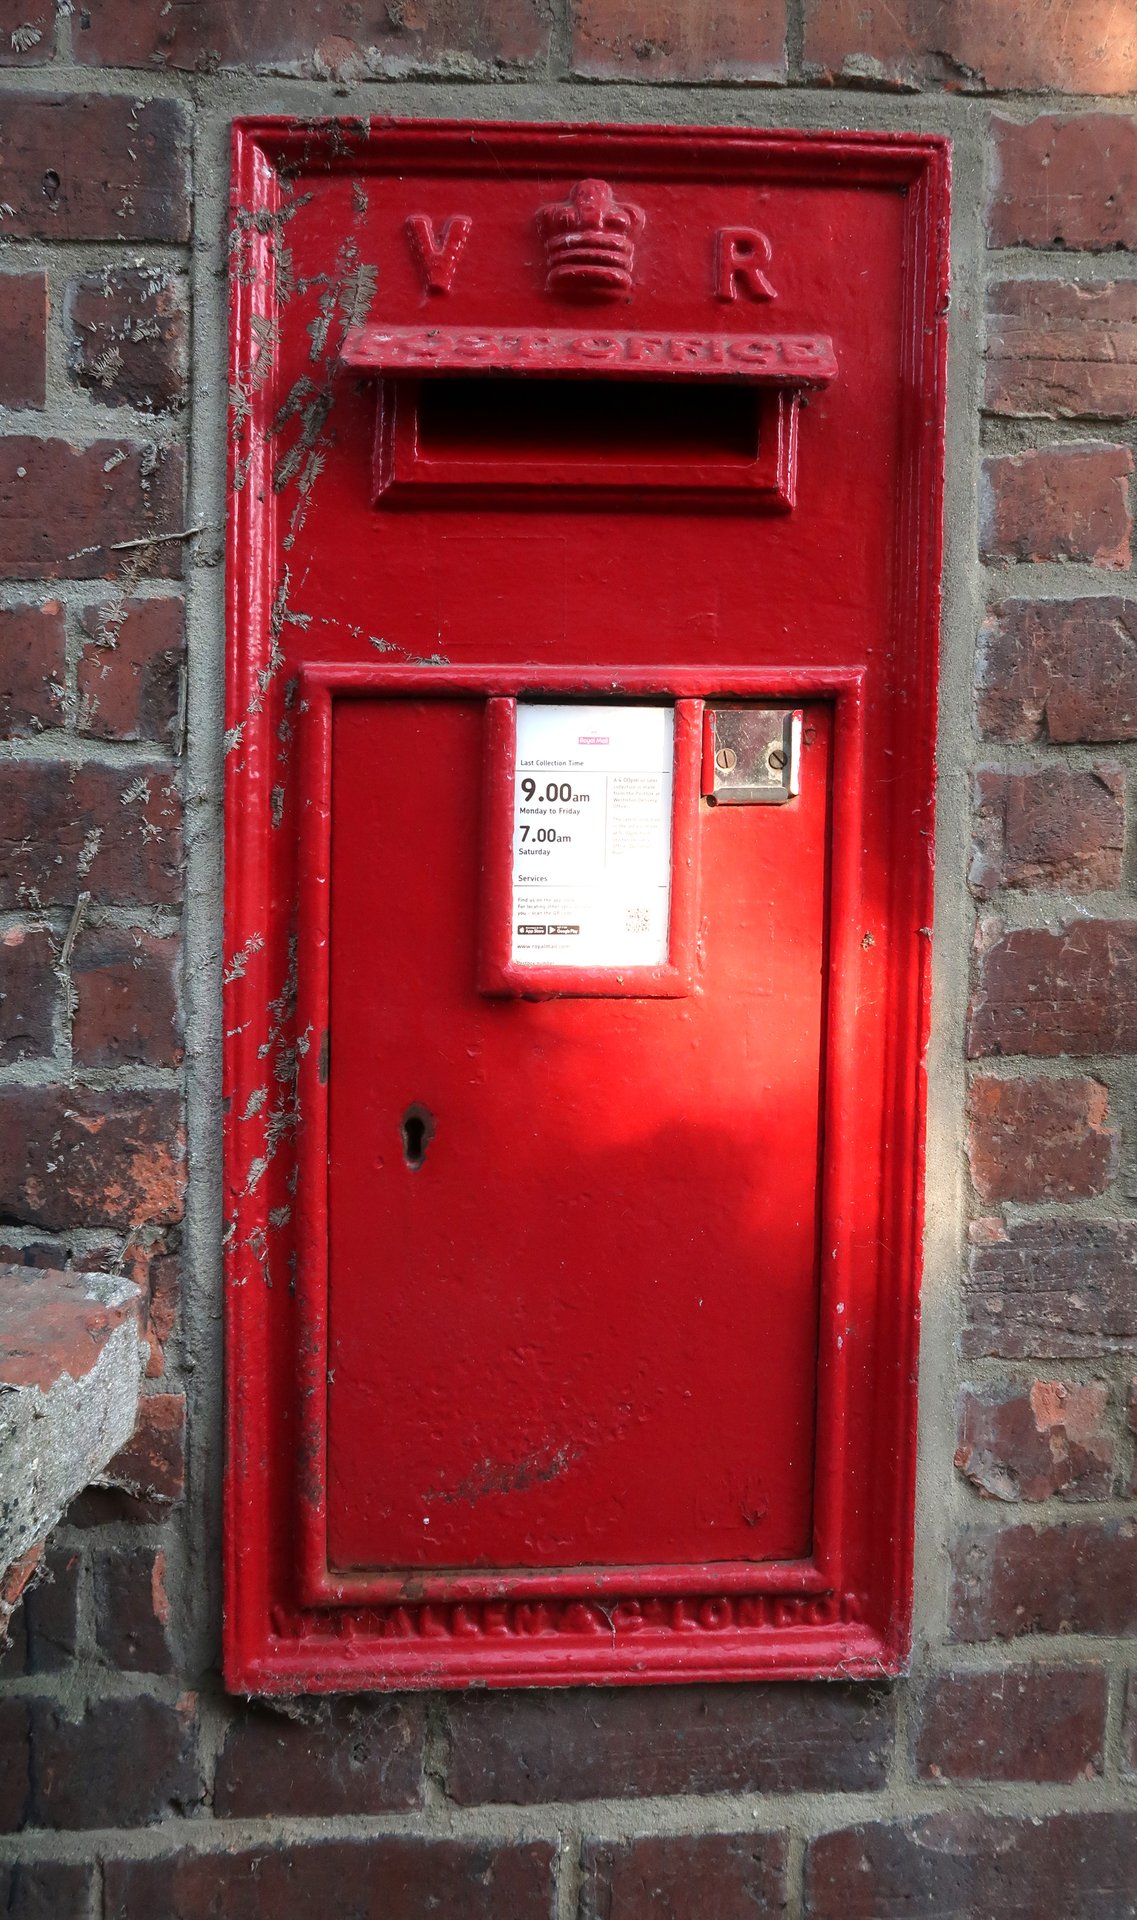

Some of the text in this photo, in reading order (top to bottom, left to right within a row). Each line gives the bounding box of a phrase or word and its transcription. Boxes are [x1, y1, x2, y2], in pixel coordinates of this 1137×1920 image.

[405, 214, 778, 302] V R
[356, 333, 828, 364] POST OFFICE
[520, 759, 534, 767] Last
[536, 759, 567, 767] Collection
[521, 778, 590, 802] 9.00am
[519, 808, 547, 816] Monday
[559, 808, 581, 816] Friday
[519, 825, 571, 843] 7.00am
[518, 848, 551, 856] Saturday
[672, 1593, 869, 1631] LONDON
